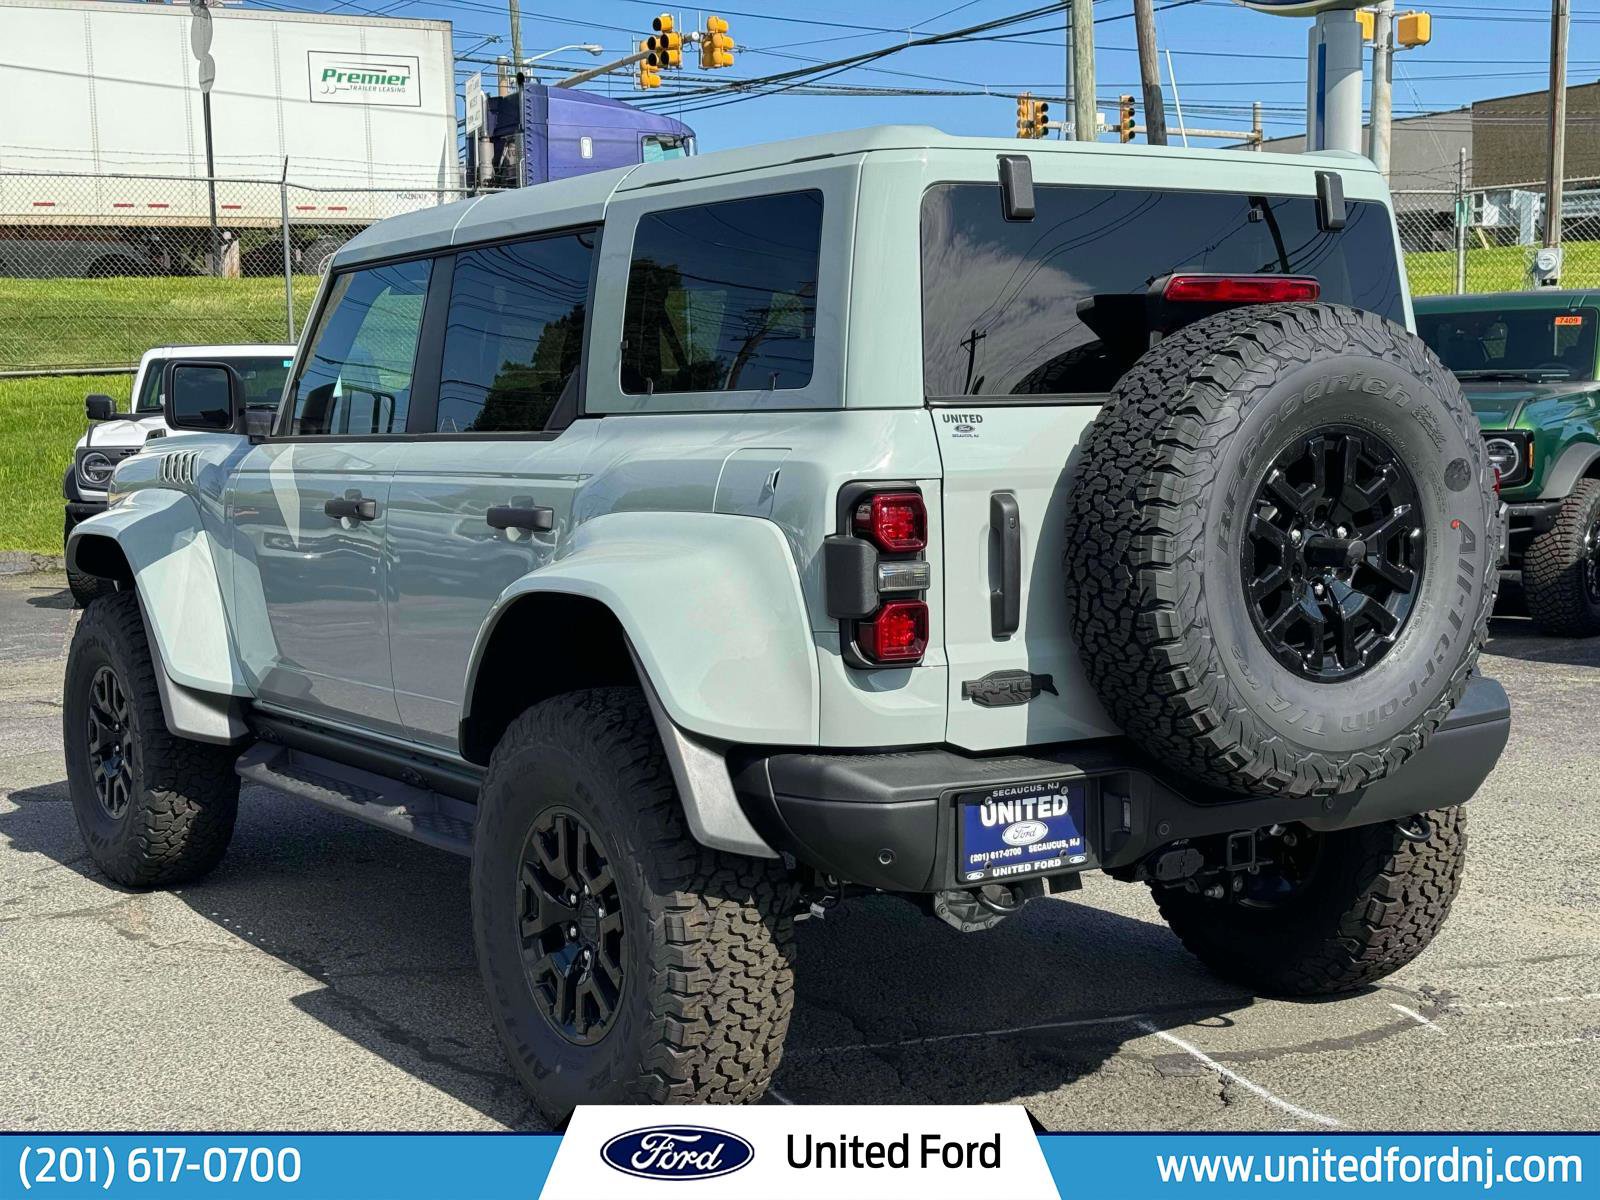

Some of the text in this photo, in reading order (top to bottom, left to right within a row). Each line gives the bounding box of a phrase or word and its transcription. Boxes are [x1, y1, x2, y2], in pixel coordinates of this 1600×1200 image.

[321, 68, 411, 86] Premier
[350, 84, 377, 92] TRAILER
[942, 413, 984, 424] UNITED
[1217, 370, 1412, 553] BFGoodrich
[992, 782, 1060, 798] SECAUCUS, NJ
[980, 794, 1069, 827] UNITED
[1028, 840, 1069, 854] SECAUCUS,
[1069, 837, 1081, 847] NJ
[992, 863, 1033, 878] UNITED
[1034, 858, 1062, 871] FORD
